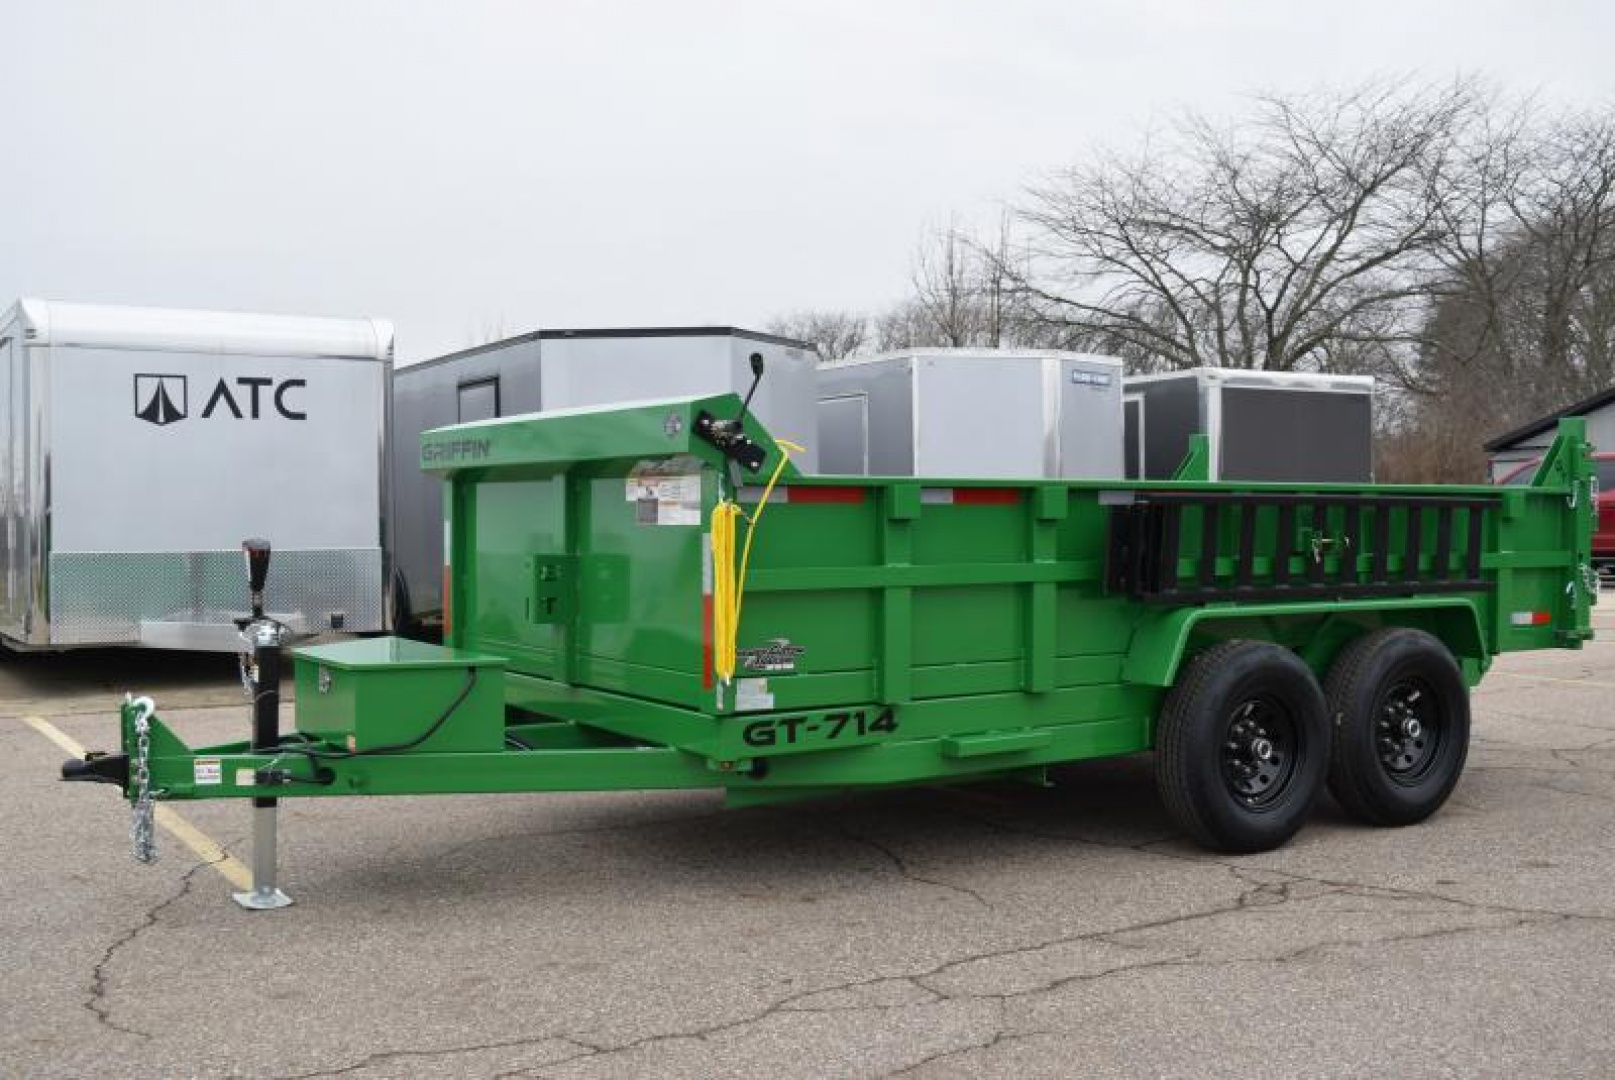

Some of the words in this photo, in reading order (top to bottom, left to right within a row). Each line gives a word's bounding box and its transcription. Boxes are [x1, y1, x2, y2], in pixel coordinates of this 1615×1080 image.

[201, 376, 307, 420] ATC
[421, 438, 490, 461] GRIFFIN
[743, 708, 898, 746] GT-714
